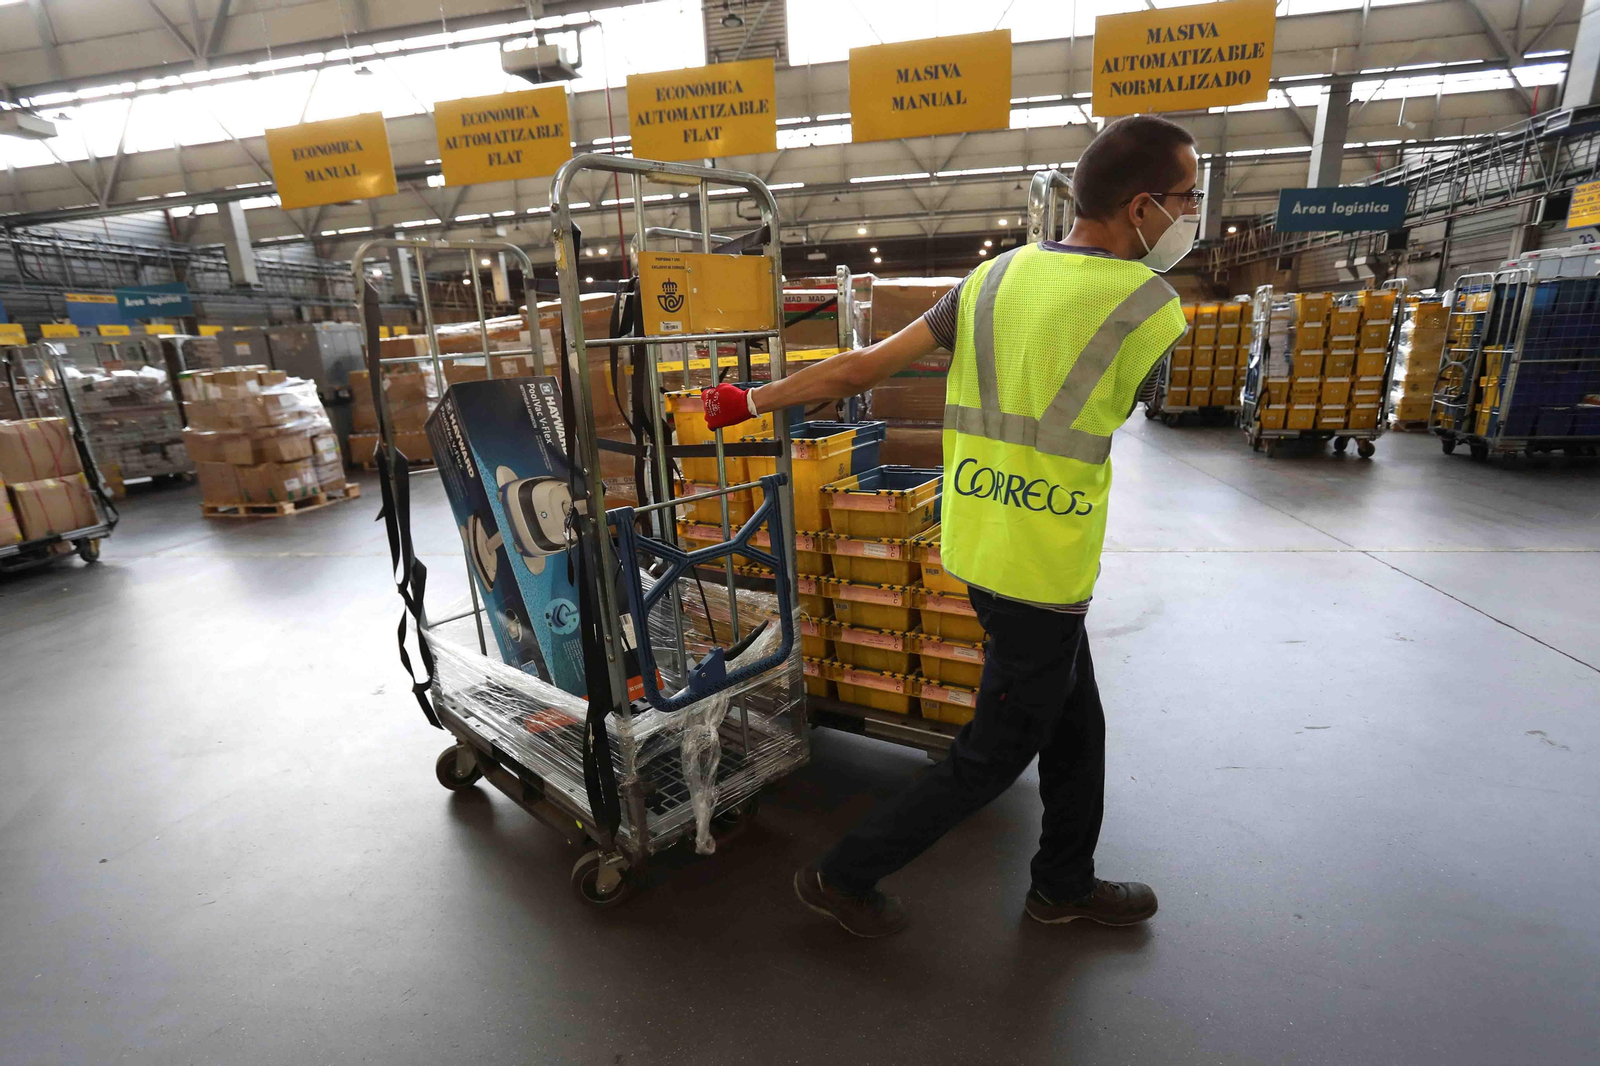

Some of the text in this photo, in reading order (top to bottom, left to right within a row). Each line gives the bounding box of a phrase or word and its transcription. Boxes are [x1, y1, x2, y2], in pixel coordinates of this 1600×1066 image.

[1146, 22, 1220, 45] MASIVA
[1101, 42, 1265, 74] AUTOMATIZABLE
[896, 63, 962, 83] MASIVA
[1109, 69, 1251, 97] NORMALIZADO
[656, 80, 743, 102] ECONOMICA
[891, 90, 967, 112] MANUAL
[461, 106, 540, 127] ECONOMICA
[635, 99, 769, 126] AUTOMATIZABLE
[444, 123, 564, 150] AUTOMATIZABLE
[683, 126, 722, 144] FLAT
[292, 140, 364, 162] ECONOMICA
[488, 151, 523, 166] FLAT
[305, 164, 360, 182] MANUAL
[1292, 201, 1390, 216] Área logística
[1579, 234, 1596, 244] 23
[527, 383, 544, 416] PoolVac
[450, 413, 474, 478] HAYWARD
[954, 458, 1092, 516] CORREOS
